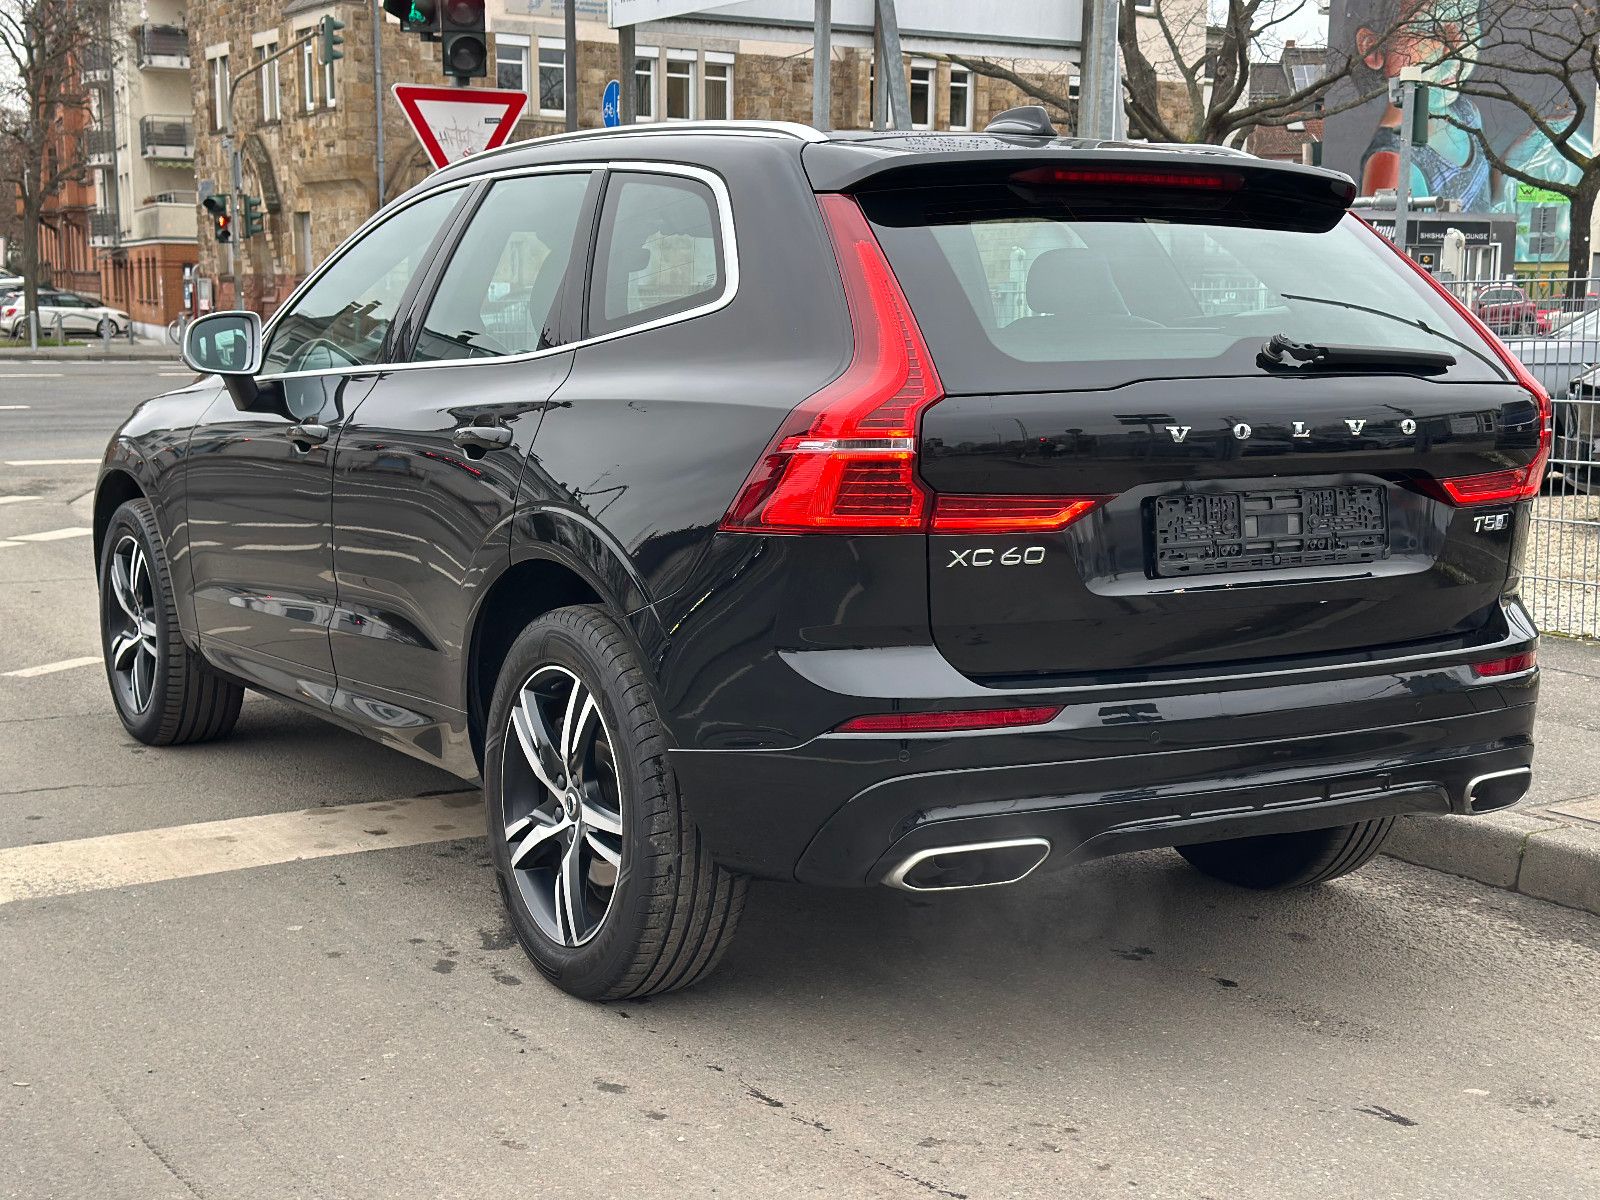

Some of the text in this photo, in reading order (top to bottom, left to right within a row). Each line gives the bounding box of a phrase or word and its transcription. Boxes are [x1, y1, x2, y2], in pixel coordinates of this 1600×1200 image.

[1420, 232, 1444, 240] SHISHA
[1463, 232, 1488, 240] OUNGE
[1165, 418, 1417, 444] VOLVO
